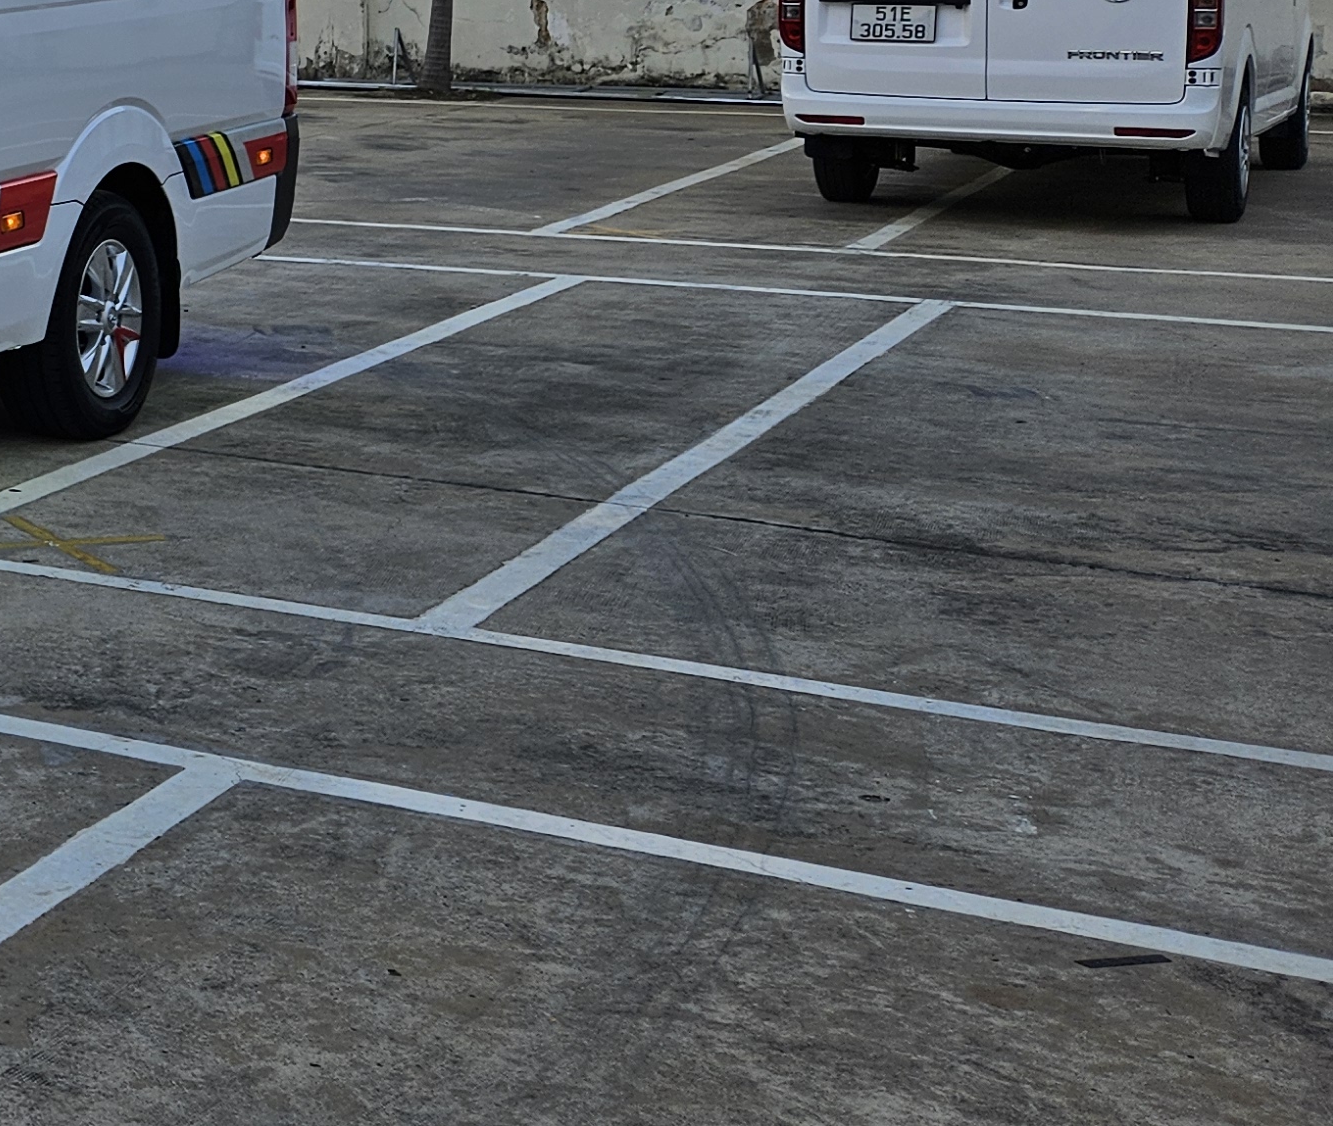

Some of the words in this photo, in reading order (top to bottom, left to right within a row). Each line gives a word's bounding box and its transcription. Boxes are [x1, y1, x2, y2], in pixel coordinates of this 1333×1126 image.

[876, 6, 912, 22] 51E
[860, 23, 926, 39] 305.58
[1067, 49, 1164, 62] FRONTIER
